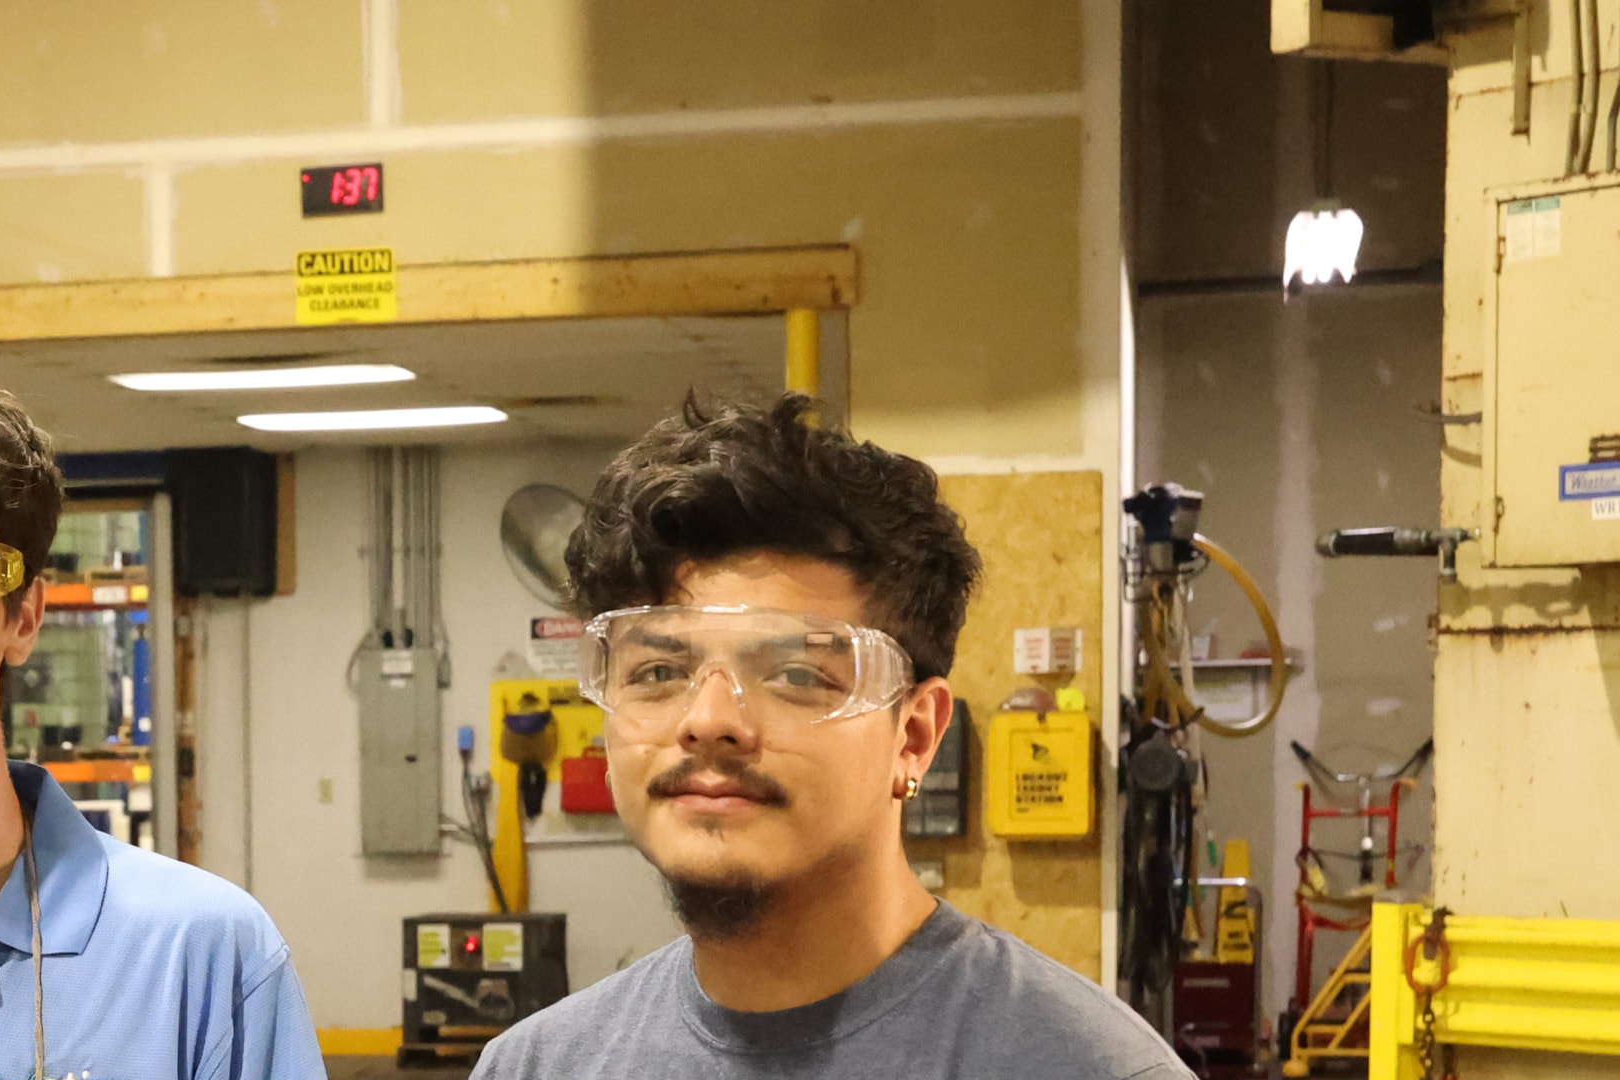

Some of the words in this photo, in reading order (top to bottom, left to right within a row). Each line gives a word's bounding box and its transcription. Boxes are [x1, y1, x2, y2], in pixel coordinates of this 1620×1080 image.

[299, 251, 390, 276] CAUTION
[297, 284, 325, 297] LOW
[328, 281, 393, 295] OVERHEAD
[309, 298, 380, 312] CLEARANCE
